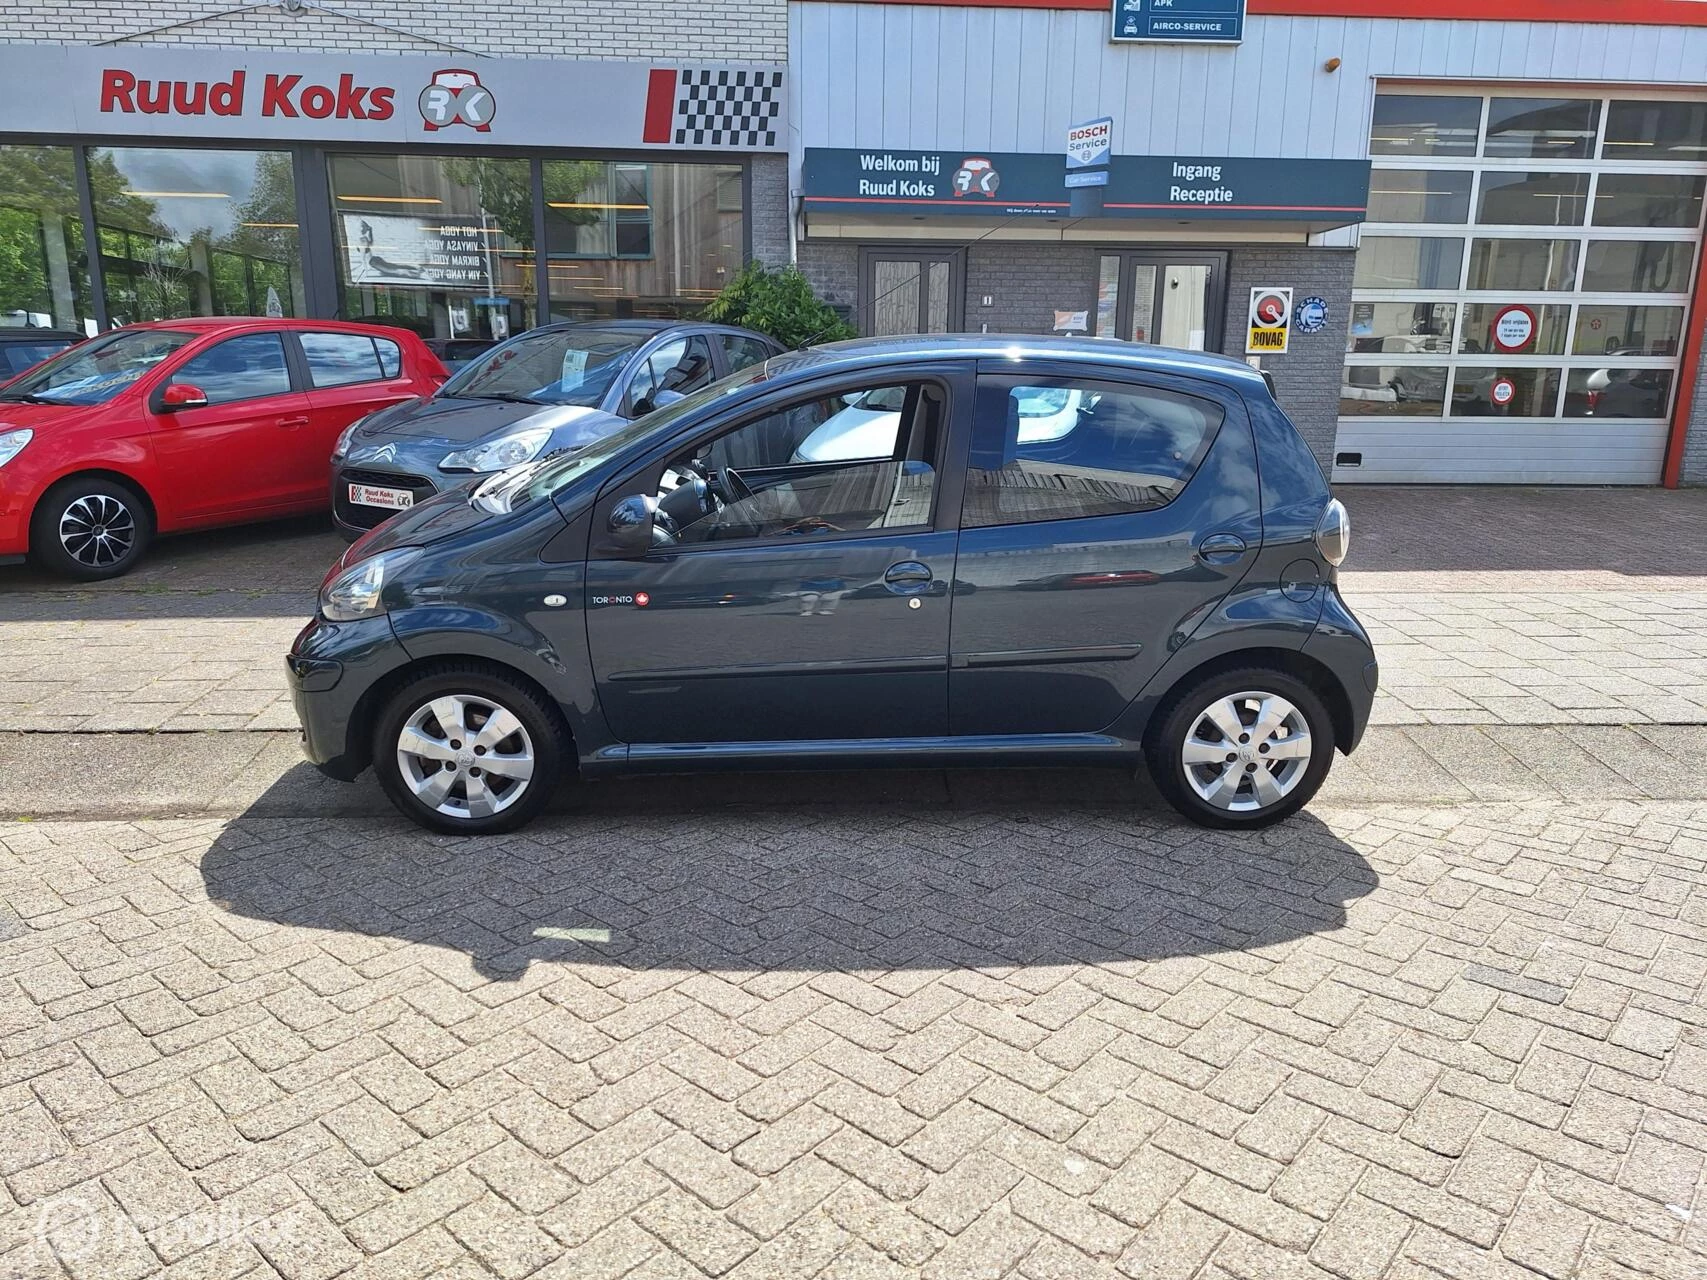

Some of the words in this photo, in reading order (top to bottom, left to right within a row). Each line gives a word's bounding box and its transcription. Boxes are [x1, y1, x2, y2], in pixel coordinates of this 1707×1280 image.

[1153, 22, 1222, 31] AIRCO-SERVICE
[100, 69, 246, 116] Ruud
[261, 73, 396, 121] Koks
[1070, 125, 1108, 141] BOSCH
[1069, 138, 1107, 151] Service
[860, 155, 919, 172] Welkom
[921, 156, 940, 176] bij
[1172, 162, 1222, 181] Ingang
[859, 180, 897, 195] Ruud
[900, 180, 935, 196] Koks
[1170, 185, 1233, 205] Receptie
[1296, 297, 1328, 313] SCHADE
[1253, 332, 1283, 346] BOVAG
[365, 488, 379, 496] Ruud
[380, 489, 394, 498] Koks
[366, 495, 394, 505] Occasions
[593, 596, 633, 604] TORONTO
